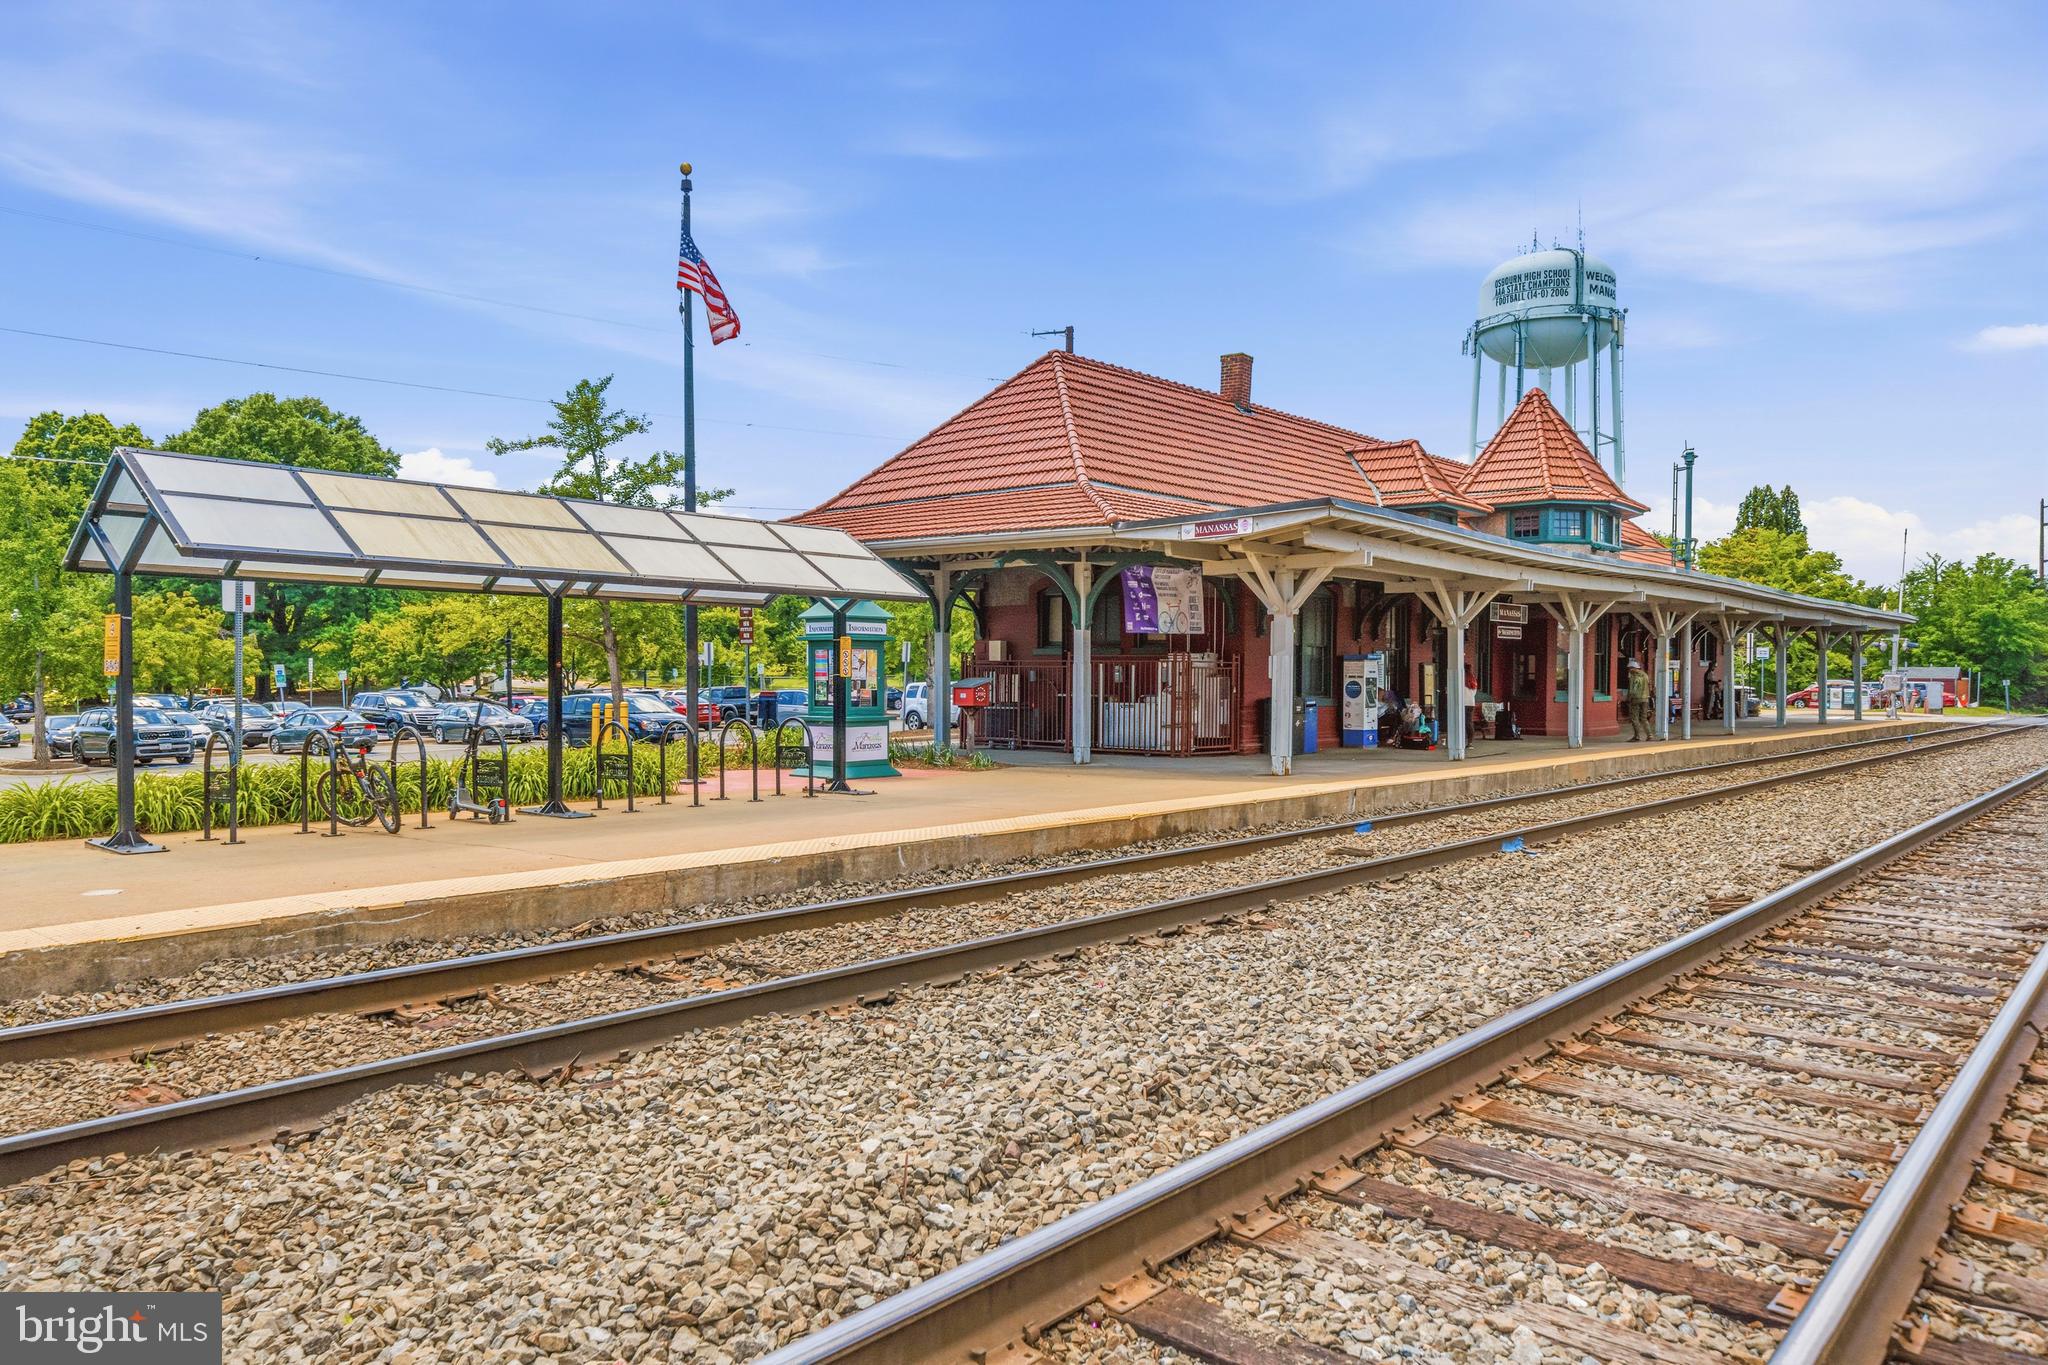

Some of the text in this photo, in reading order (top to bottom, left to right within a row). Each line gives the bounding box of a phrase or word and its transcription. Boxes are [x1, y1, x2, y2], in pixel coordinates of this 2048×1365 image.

[1495, 269, 1571, 289] OSBOURN HIGH SCHOOL
[1507, 280, 1526, 294] STATE
[1528, 277, 1570, 290] CHAMPIONS
[1495, 287, 1569, 307] FOOTBALL (14-0) 2006
[1195, 522, 1239, 535] MANASSAS
